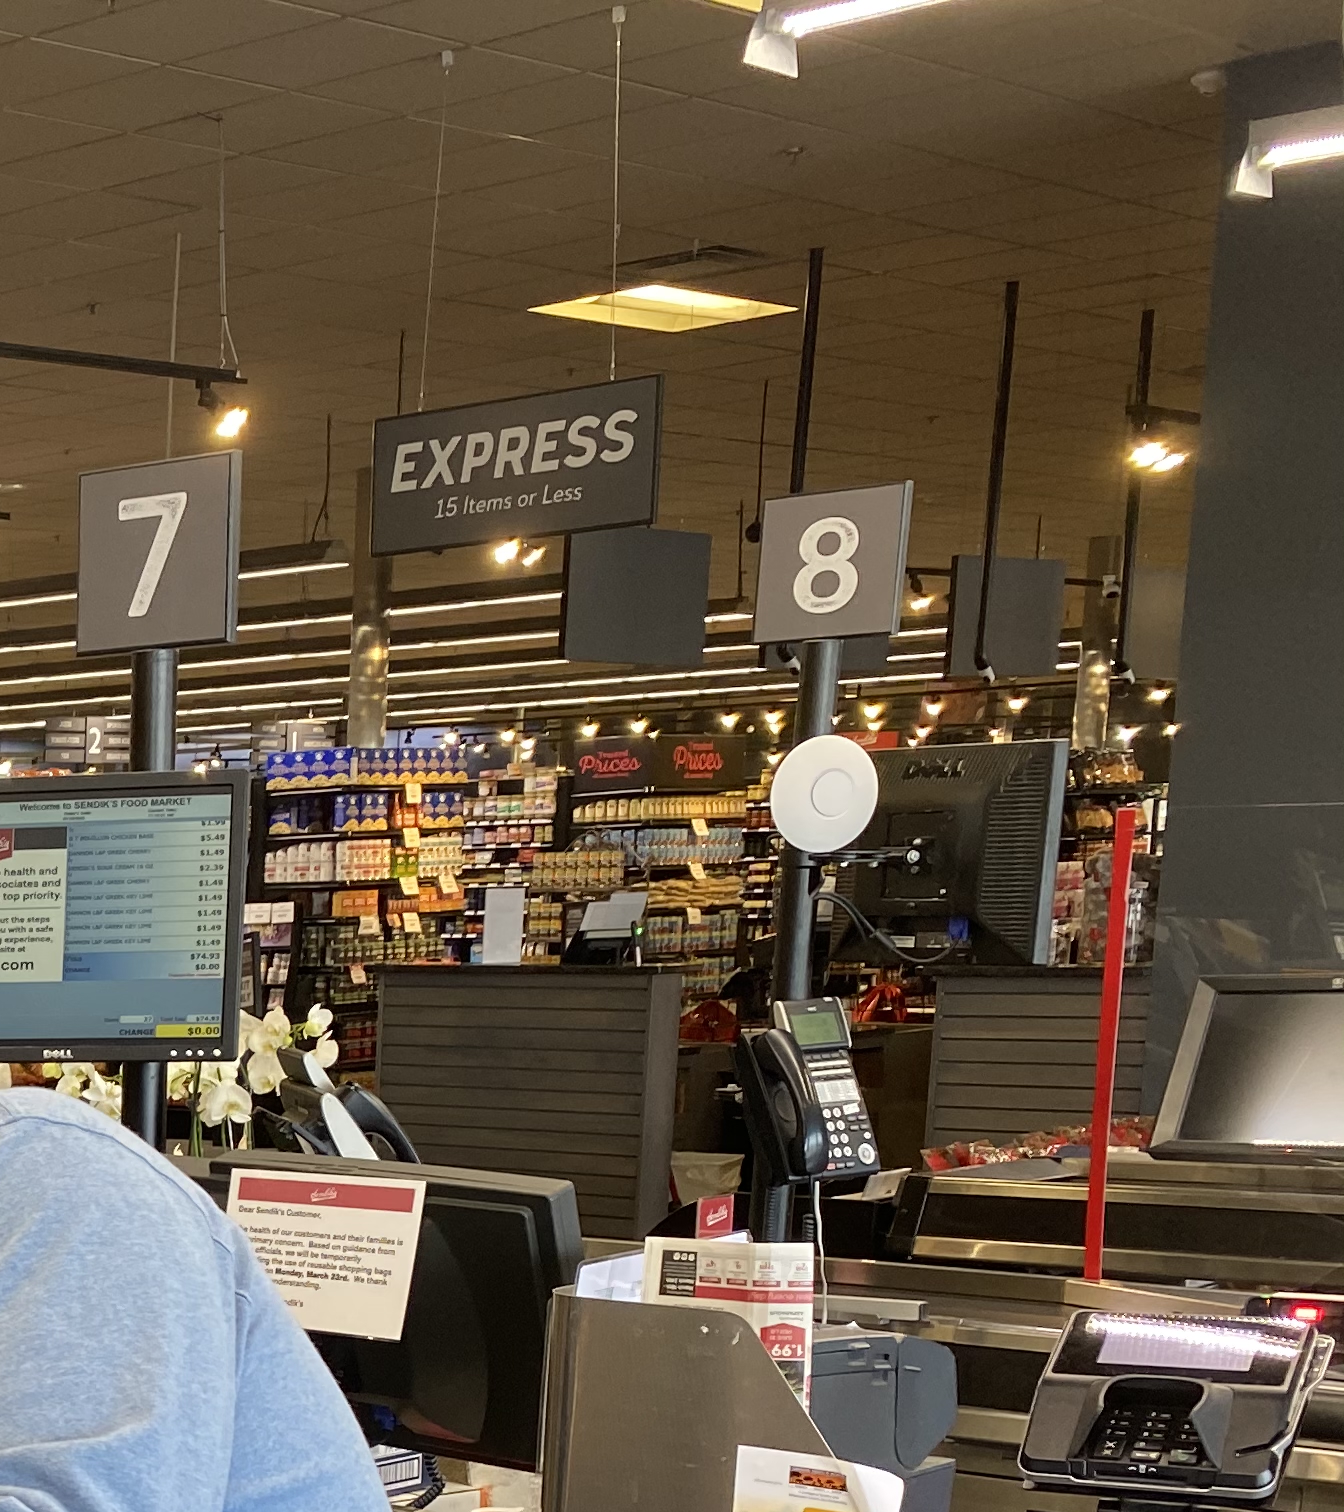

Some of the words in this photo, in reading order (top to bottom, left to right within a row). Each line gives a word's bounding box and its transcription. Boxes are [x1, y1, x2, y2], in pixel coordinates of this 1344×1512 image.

[390, 409, 638, 493] EXPRESS
[434, 497, 459, 519] 15
[463, 495, 512, 515] Items
[518, 492, 537, 508] or
[542, 484, 583, 505] Less
[118, 491, 188, 618] 7
[793, 516, 860, 614] 8
[89, 727, 101, 754] 2
[673, 746, 723, 771] Prices
[579, 755, 643, 775] Prices
[19, 802, 61, 811] Welcome
[62, 801, 71, 810] to
[74, 799, 118, 810] SENDIK'S
[120, 799, 148, 809] FOOD
[150, 797, 191, 807] MARKET
[200, 834, 225, 842] $5.49
[200, 849, 225, 857] $1.49
[4, 867, 36, 877] health
[39, 866, 58, 875] and
[199, 864, 224, 872] $2.39
[42, 879, 61, 888] and
[3, 893, 20, 903] top
[23, 892, 62, 902] priority.
[198, 894, 223, 902] $1.49
[197, 909, 222, 917] $1.49
[27, 917, 50, 925] steps
[8, 926, 26, 934] with
[35, 925, 54, 933] safe
[197, 924, 222, 932] $1.49
[4, 936, 53, 946] experience,
[195, 963, 220, 971] $0.00
[187, 1027, 220, 1036] $0.00
[43, 1049, 74, 1059] DELL
[238, 1205, 255, 1213] Dear
[256, 1206, 285, 1216] Sendik's
[287, 1209, 322, 1219] Customer,
[249, 1226, 271, 1235] health
[272, 1227, 279, 1235] of
[294, 1230, 331, 1239] customers
[333, 1232, 346, 1241] and
[348, 1234, 365, 1242] their
[366, 1235, 395, 1245] families
[397, 1238, 403, 1246] is
[274, 1239, 305, 1248] concern.
[308, 1240, 330, 1250] Based
[342, 1244, 376, 1255] guidance
[378, 1246, 396, 1256] from
[320, 1252, 362, 1264] temporarily
[271, 1257, 283, 1265] the
[284, 1258, 297, 1267] use
[298, 1259, 306, 1268] of
[307, 1261, 337, 1271] reusable
[339, 1264, 372, 1276] shopping
[374, 1267, 392, 1276] bags
[275, 1267, 304, 1278] Monday,
[306, 1271, 329, 1280] March
[330, 1273, 349, 1282] 23rd.
[353, 1275, 365, 1283] We
[366, 1276, 388, 1286] thank
[771, 1343, 804, 1356] 1.99
